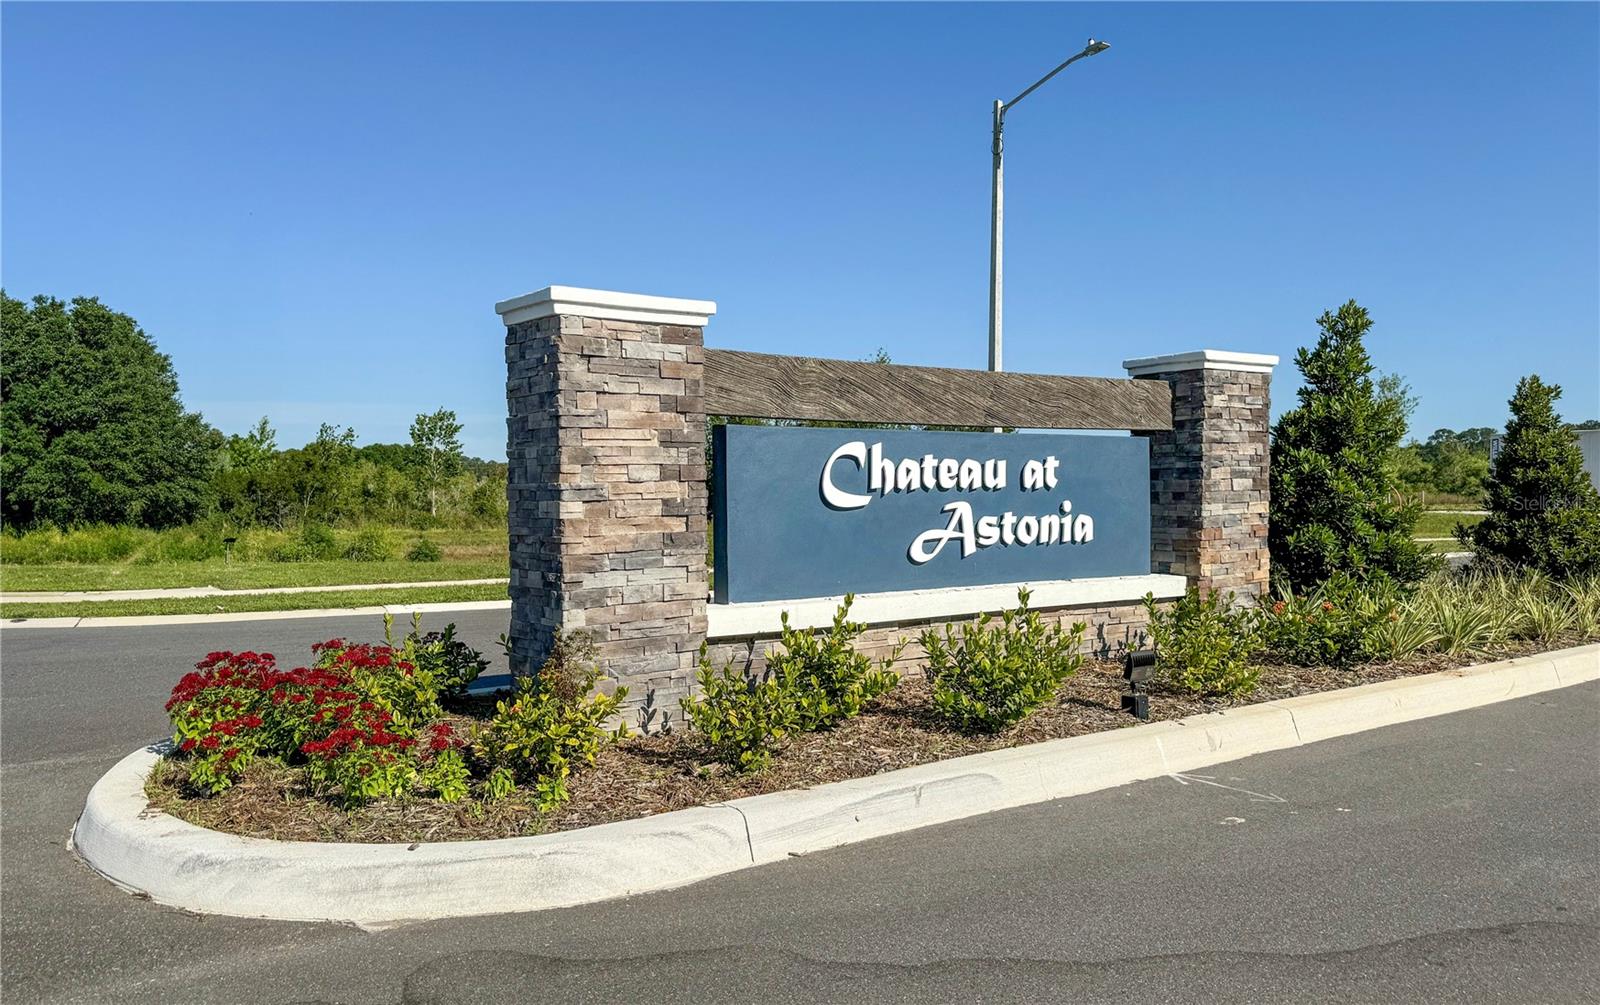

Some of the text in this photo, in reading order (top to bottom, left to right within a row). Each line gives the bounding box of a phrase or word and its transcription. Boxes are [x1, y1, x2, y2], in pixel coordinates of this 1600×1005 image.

[820, 441, 1060, 509] Chateau at
[909, 500, 1094, 564] Astonia
